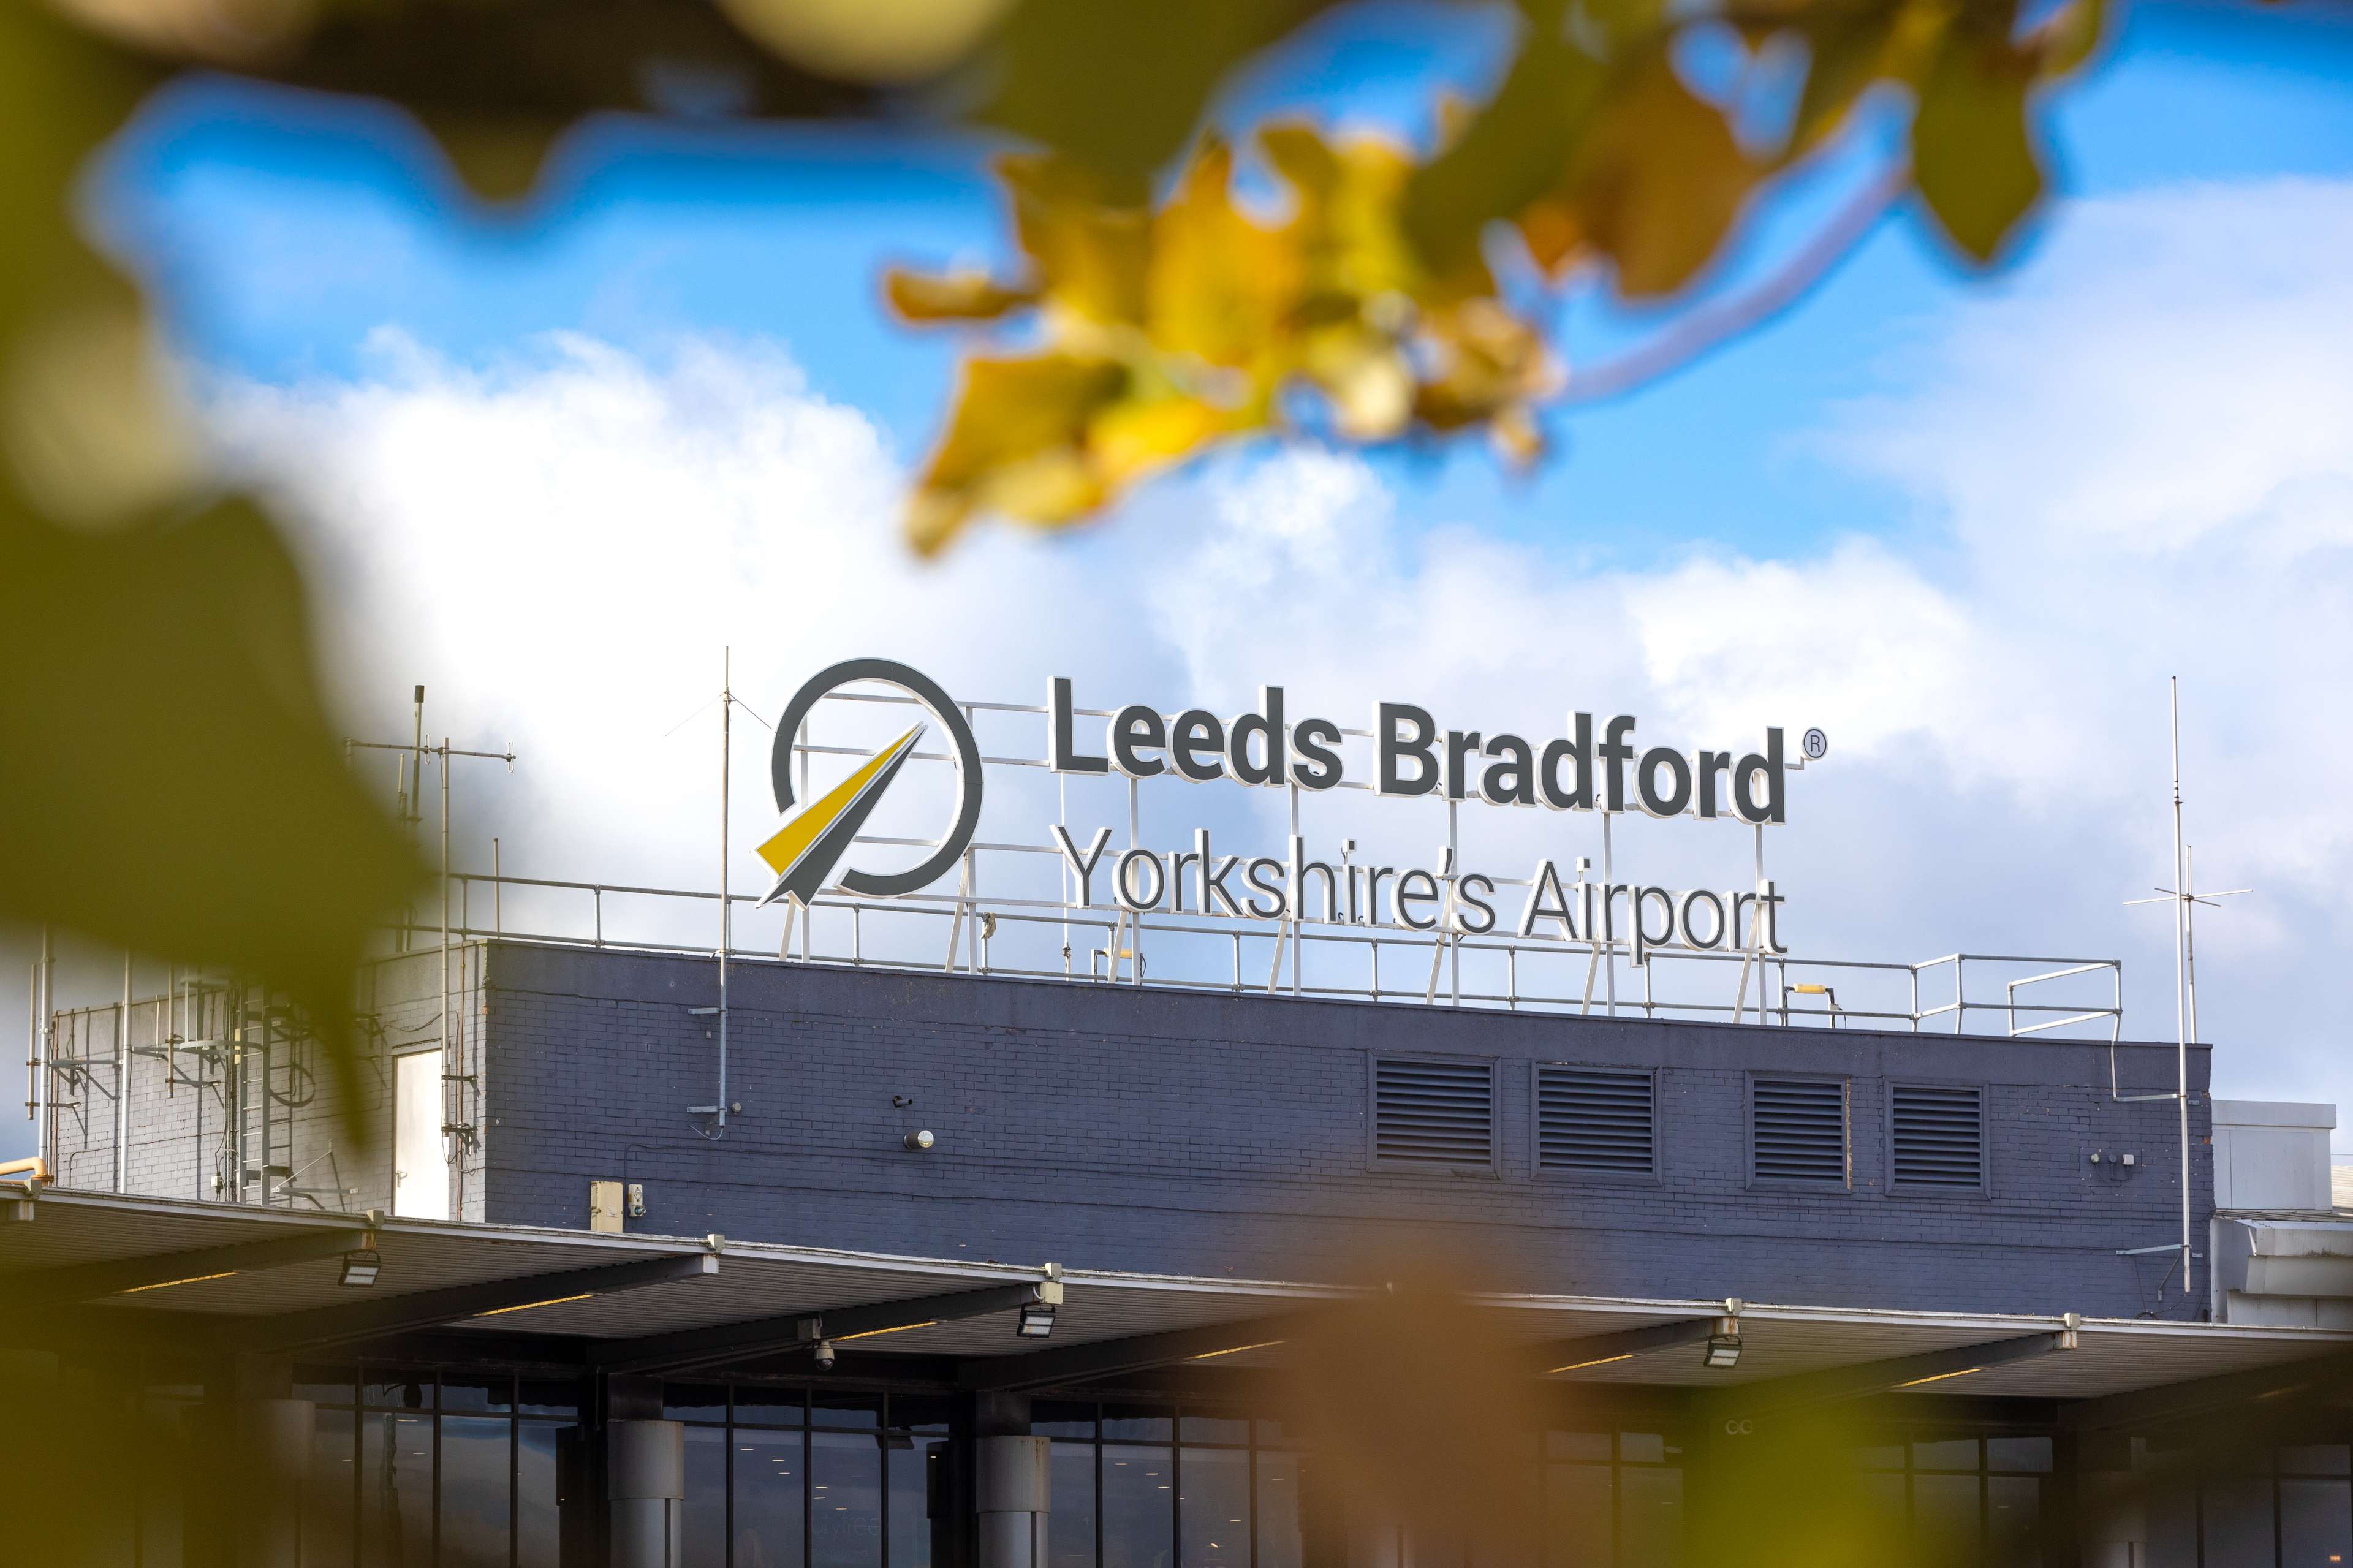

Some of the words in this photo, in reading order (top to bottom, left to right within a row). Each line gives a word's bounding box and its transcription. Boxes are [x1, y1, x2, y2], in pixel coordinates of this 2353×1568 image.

[1052, 677, 1343, 790] Leeds
[1378, 702, 1786, 824] Bradford
[1056, 826, 1496, 934] Yorkshire's
[1523, 860, 1789, 966] Airport
